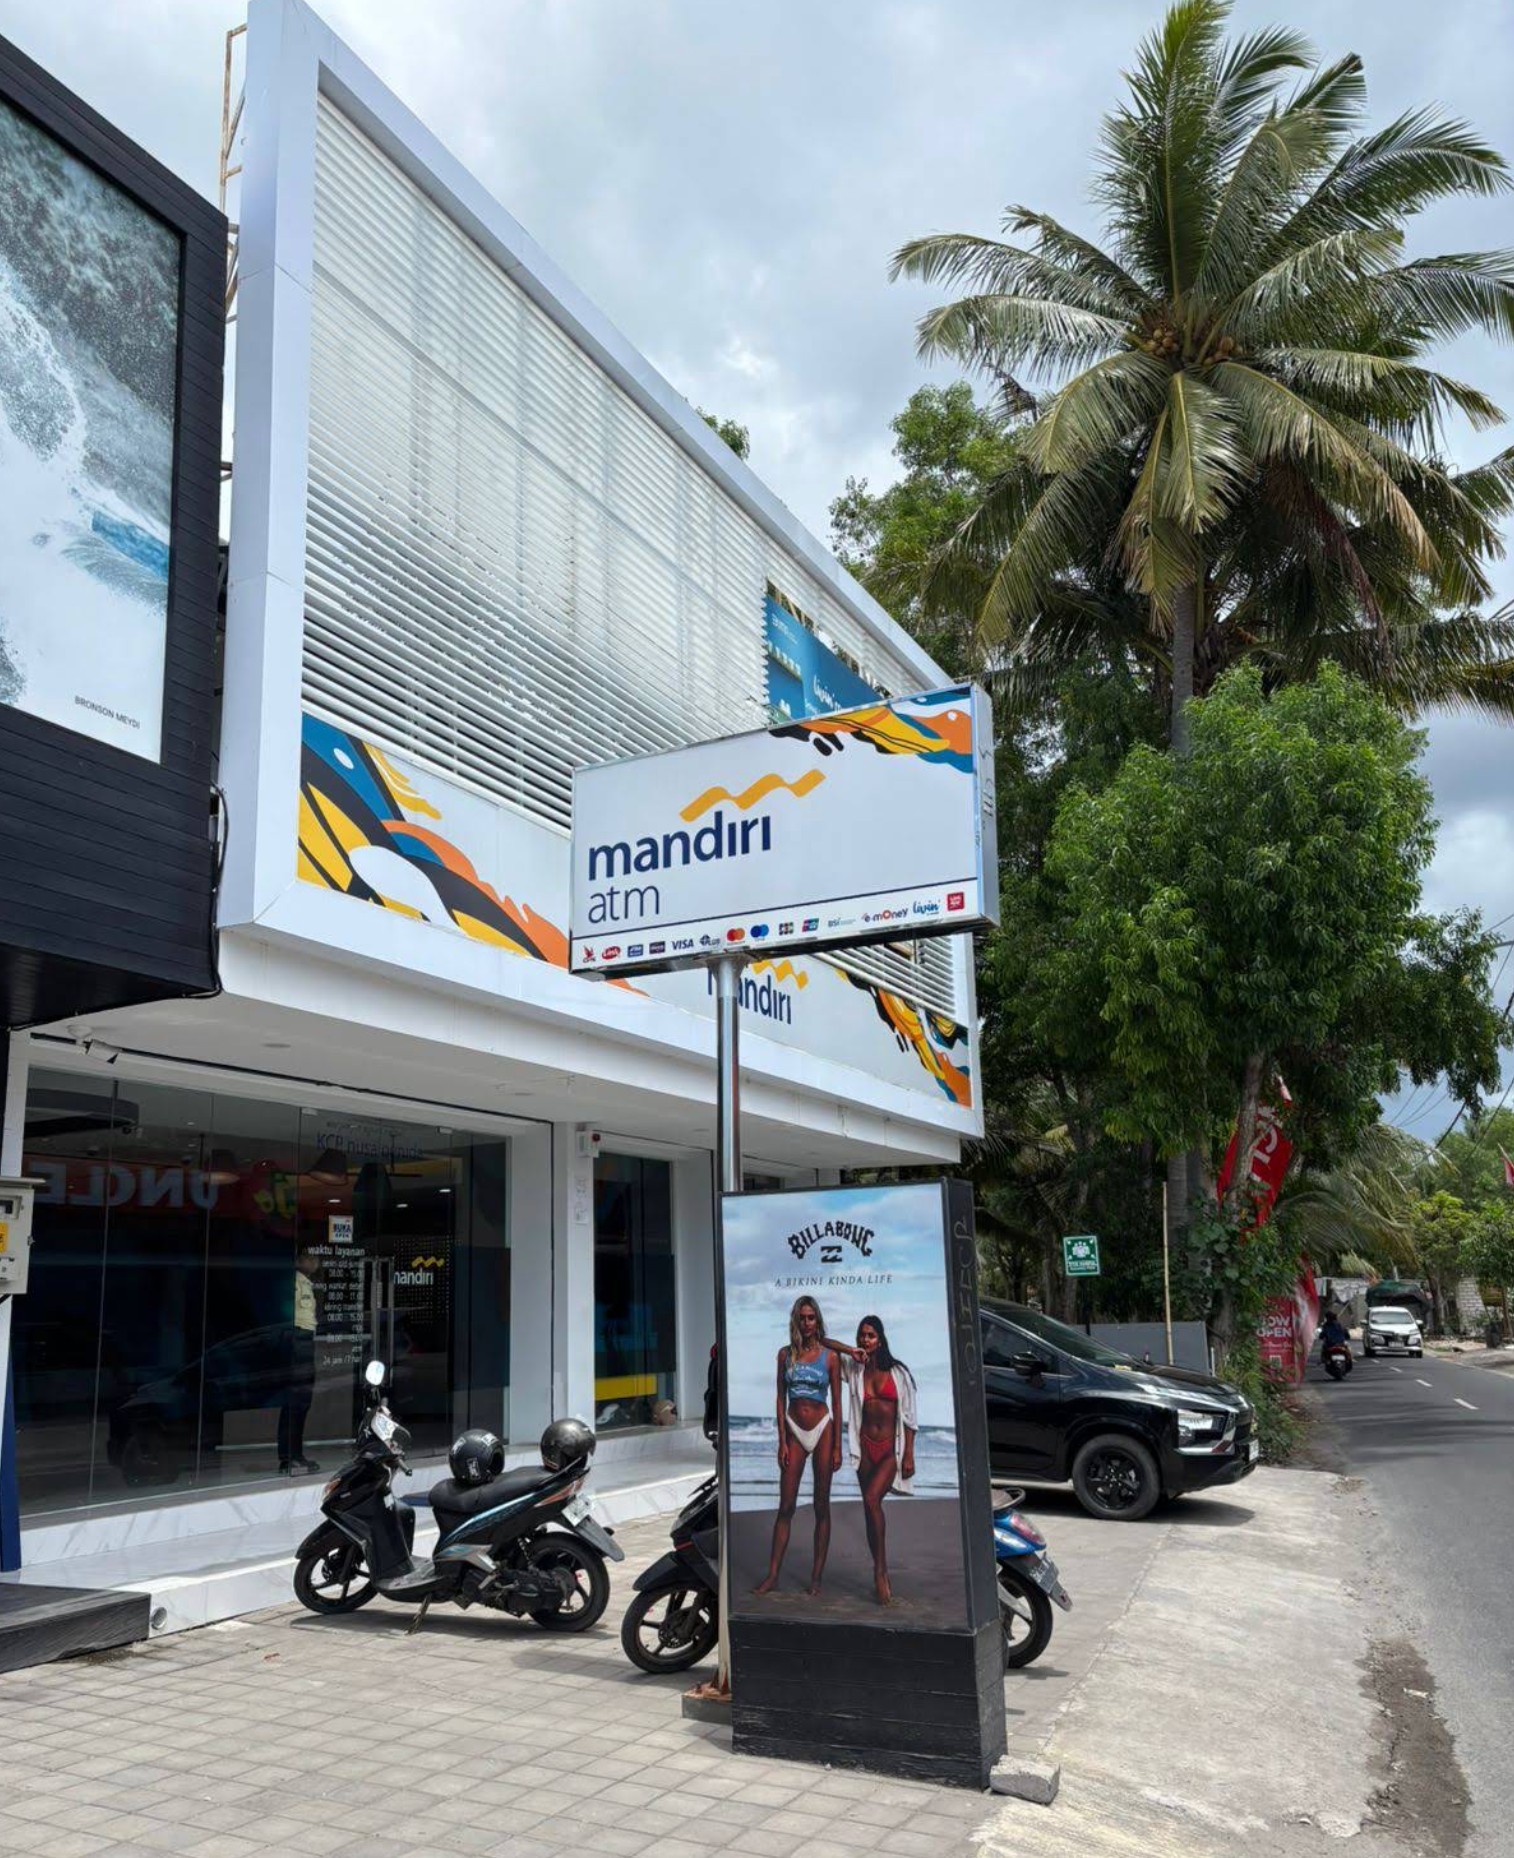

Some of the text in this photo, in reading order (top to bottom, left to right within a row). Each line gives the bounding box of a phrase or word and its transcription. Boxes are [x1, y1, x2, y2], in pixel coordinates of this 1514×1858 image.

[75, 695, 114, 718] BRONSON
[588, 811, 771, 881] mandiri
[588, 886, 660, 924] atm
[672, 939, 694, 950] VISA
[708, 967, 791, 1024] ndiri
[787, 1220, 875, 1260] BILLABONG
[308, 1245, 365, 1259] waktu layanan
[775, 1274, 893, 1287] A BIKINI KINDA LIFE
[1256, 1327, 1292, 1338] OPEN
